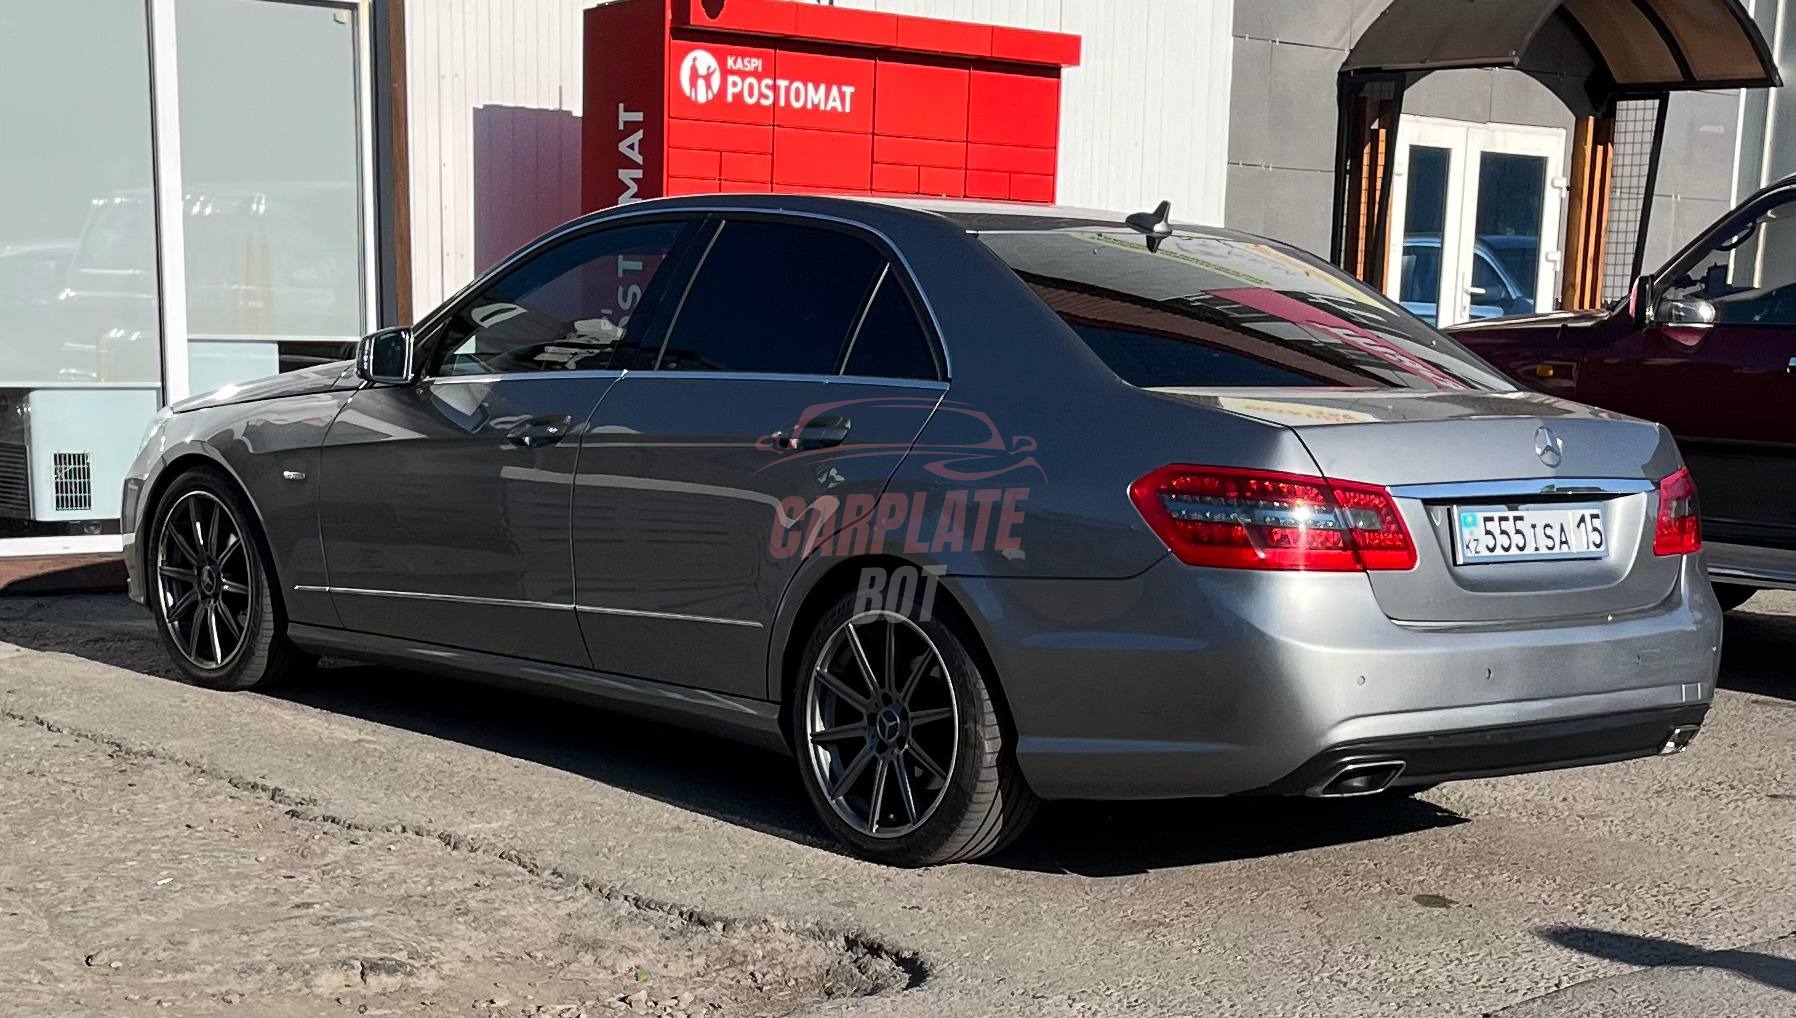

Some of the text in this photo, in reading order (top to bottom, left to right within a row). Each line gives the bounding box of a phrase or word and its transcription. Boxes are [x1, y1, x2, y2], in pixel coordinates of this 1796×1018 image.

[727, 55, 763, 73] KASPI
[726, 75, 856, 113] POSTOMAT
[1465, 513, 1604, 554] KZ 555 ISA 15
